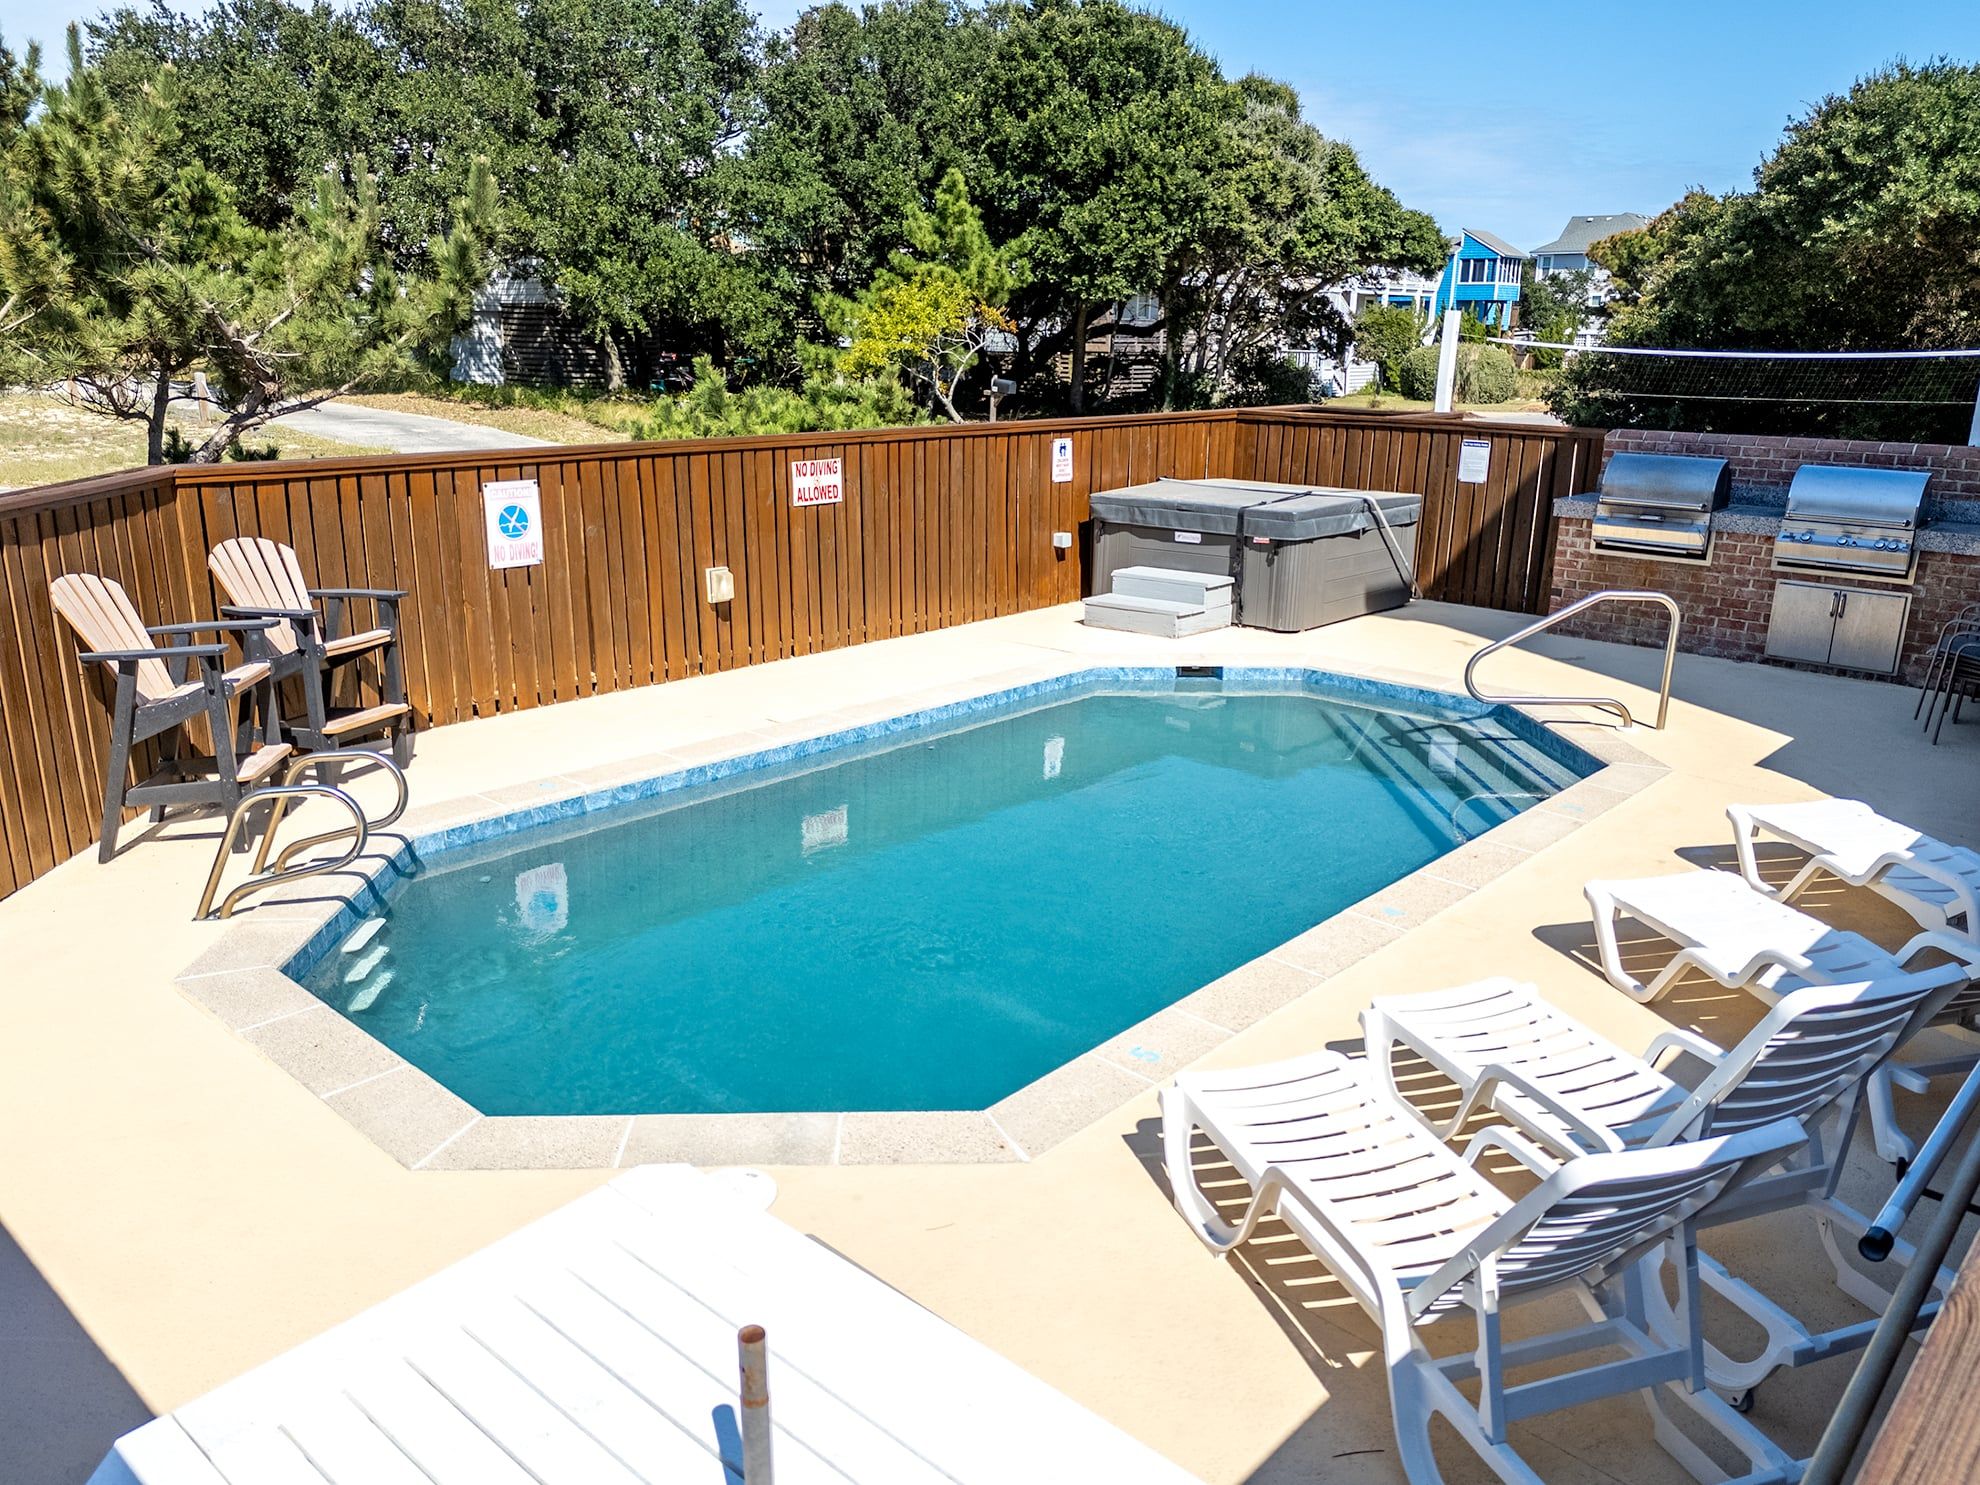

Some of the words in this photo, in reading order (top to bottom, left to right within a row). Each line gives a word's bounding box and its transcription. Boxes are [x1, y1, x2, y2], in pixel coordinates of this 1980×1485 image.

[795, 463, 807, 477] NO
[810, 460, 838, 476] DIVING
[797, 485, 838, 502] ALLOWED
[494, 545, 505, 562] NO
[510, 542, 538, 561] DIVING!
